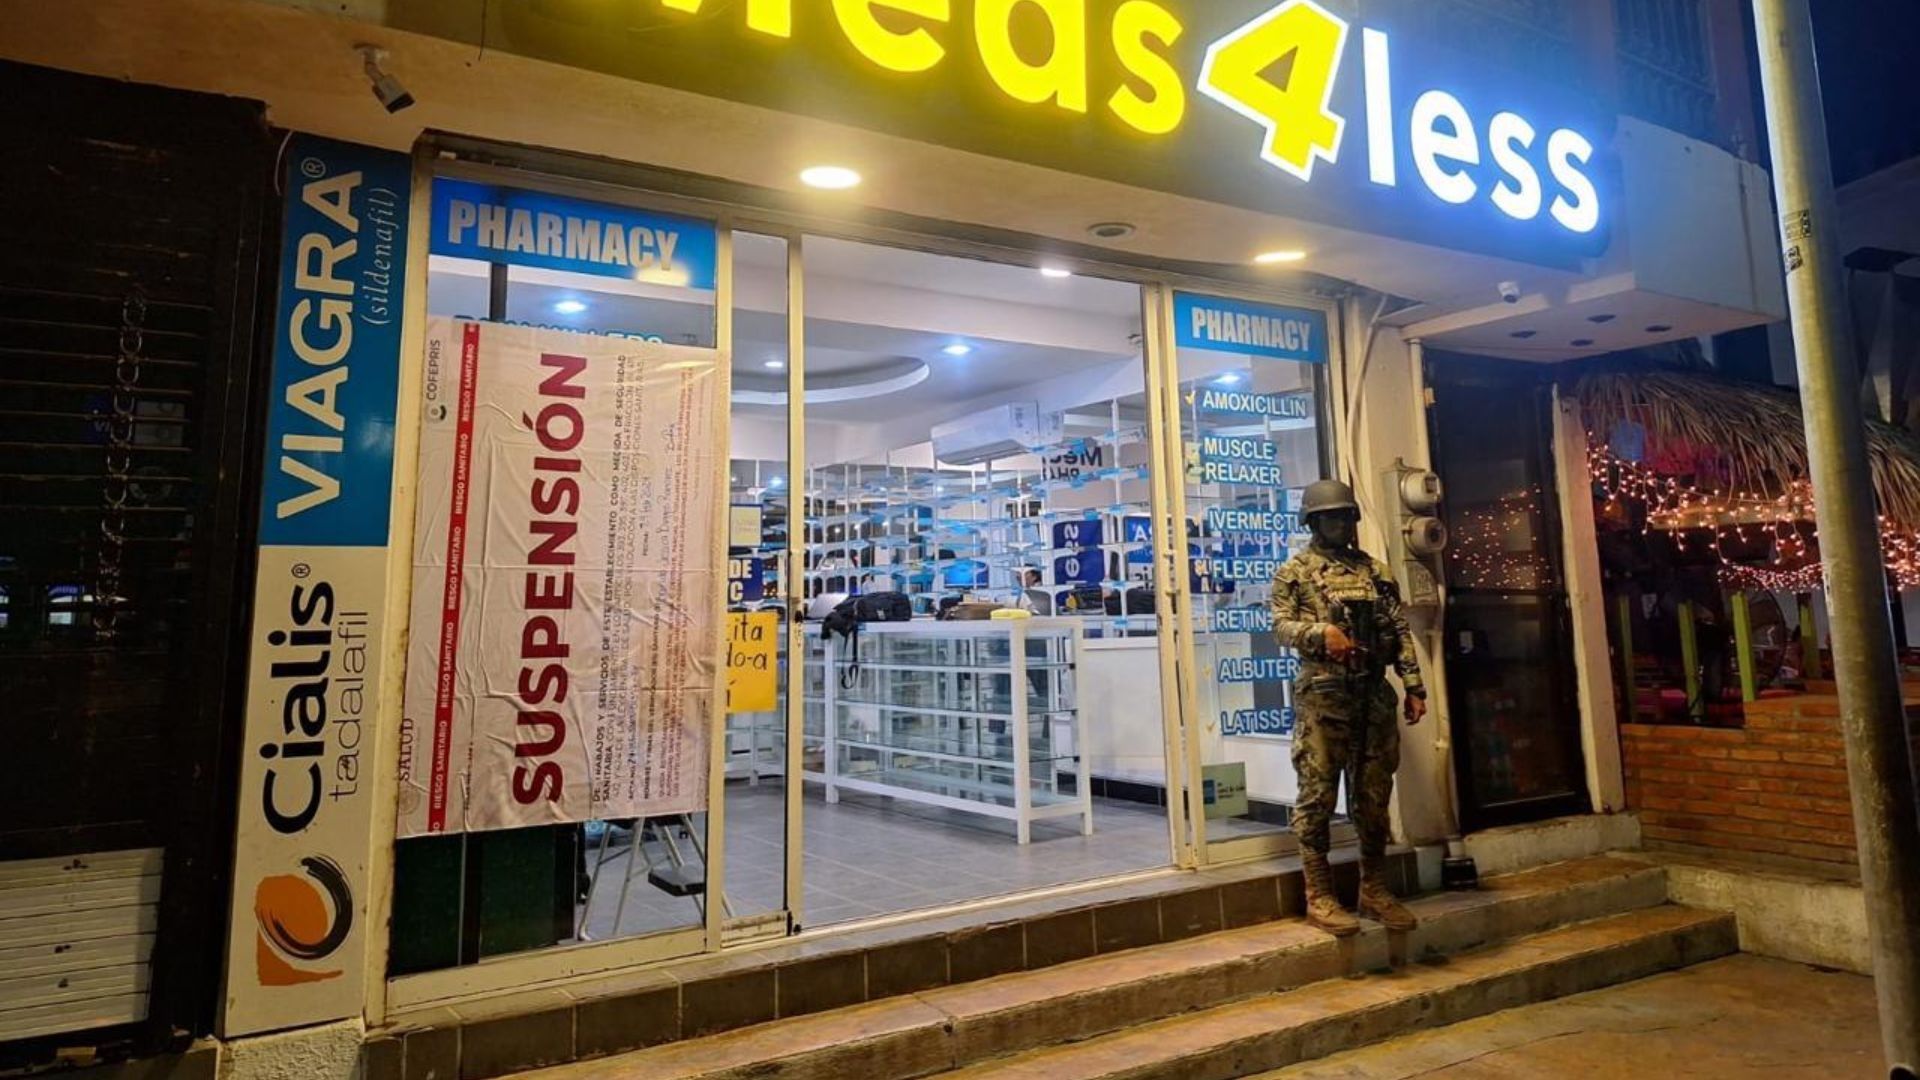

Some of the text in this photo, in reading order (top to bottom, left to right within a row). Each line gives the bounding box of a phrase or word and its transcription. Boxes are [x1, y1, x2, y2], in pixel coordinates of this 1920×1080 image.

[361, 186, 399, 325] (sildenafil)
[448, 200, 678, 271] PHARMACY
[1191, 307, 1311, 351] PHARMACY
[426, 339, 440, 401] COFEPRIS
[464, 344, 474, 389] SANITARIO
[462, 392, 471, 422] RIESGO
[1203, 391, 1307, 417] AMOXICILLIN
[458, 433, 468, 480] SANITARIO
[1204, 437, 1274, 460] MUSCLE
[1205, 462, 1282, 485] RELAXER
[455, 482, 466, 514] RIESGO
[450, 526, 462, 574] SANITARIO
[1213, 560, 1281, 579] FLEXERI
[448, 575, 458, 609] RIESGO
[512, 353, 588, 804] SUSPENSIÓN
[598, 656, 608, 708] SERVICIOS
[604, 511, 616, 600] ESTABLECIMIENTO
[610, 475, 618, 505] COMO
[442, 622, 454, 671] SANITARIO
[441, 674, 450, 708] RIESGO
[1220, 659, 1299, 680] ALBUTER
[328, 611, 369, 802] tadalafil
[1222, 709, 1292, 733] LATISSE
[400, 718, 415, 781] SALUD
[435, 720, 447, 771] SANITARIO
[434, 774, 444, 809] RIESGO
[602, 745, 612, 800] SANITARIA
